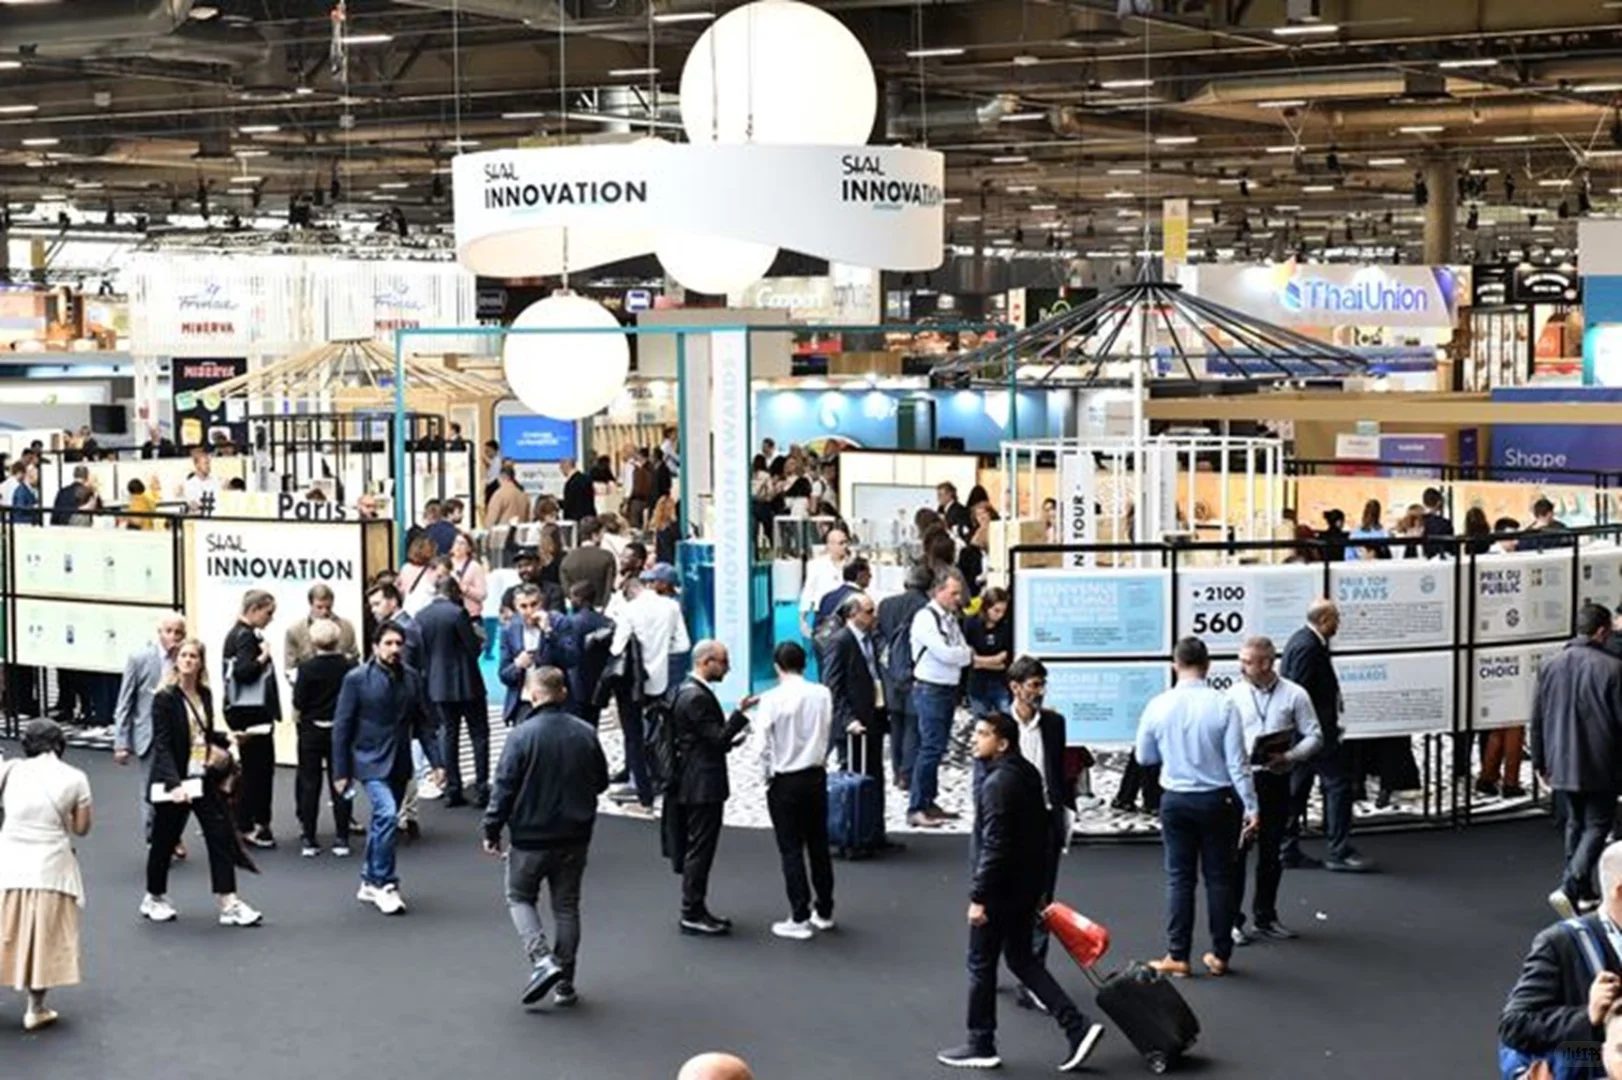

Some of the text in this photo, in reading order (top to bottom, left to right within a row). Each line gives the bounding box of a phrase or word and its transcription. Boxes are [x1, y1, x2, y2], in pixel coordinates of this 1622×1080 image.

[484, 162, 519, 183] SIAL
[841, 155, 885, 175] SIAL
[484, 180, 647, 209] INNOVATION
[1505, 448, 1567, 468] Shape
[278, 493, 346, 520] Paris
[1073, 495, 1086, 539] TOUR
[206, 533, 247, 552] SIAL
[207, 556, 352, 580] INNOVATION
[1205, 586, 1245, 601] 2100
[1353, 586, 1388, 601] PAYS
[1480, 581, 1521, 595] PUBLIC
[1192, 611, 1243, 634] 560
[1479, 664, 1520, 679] CHOICE
